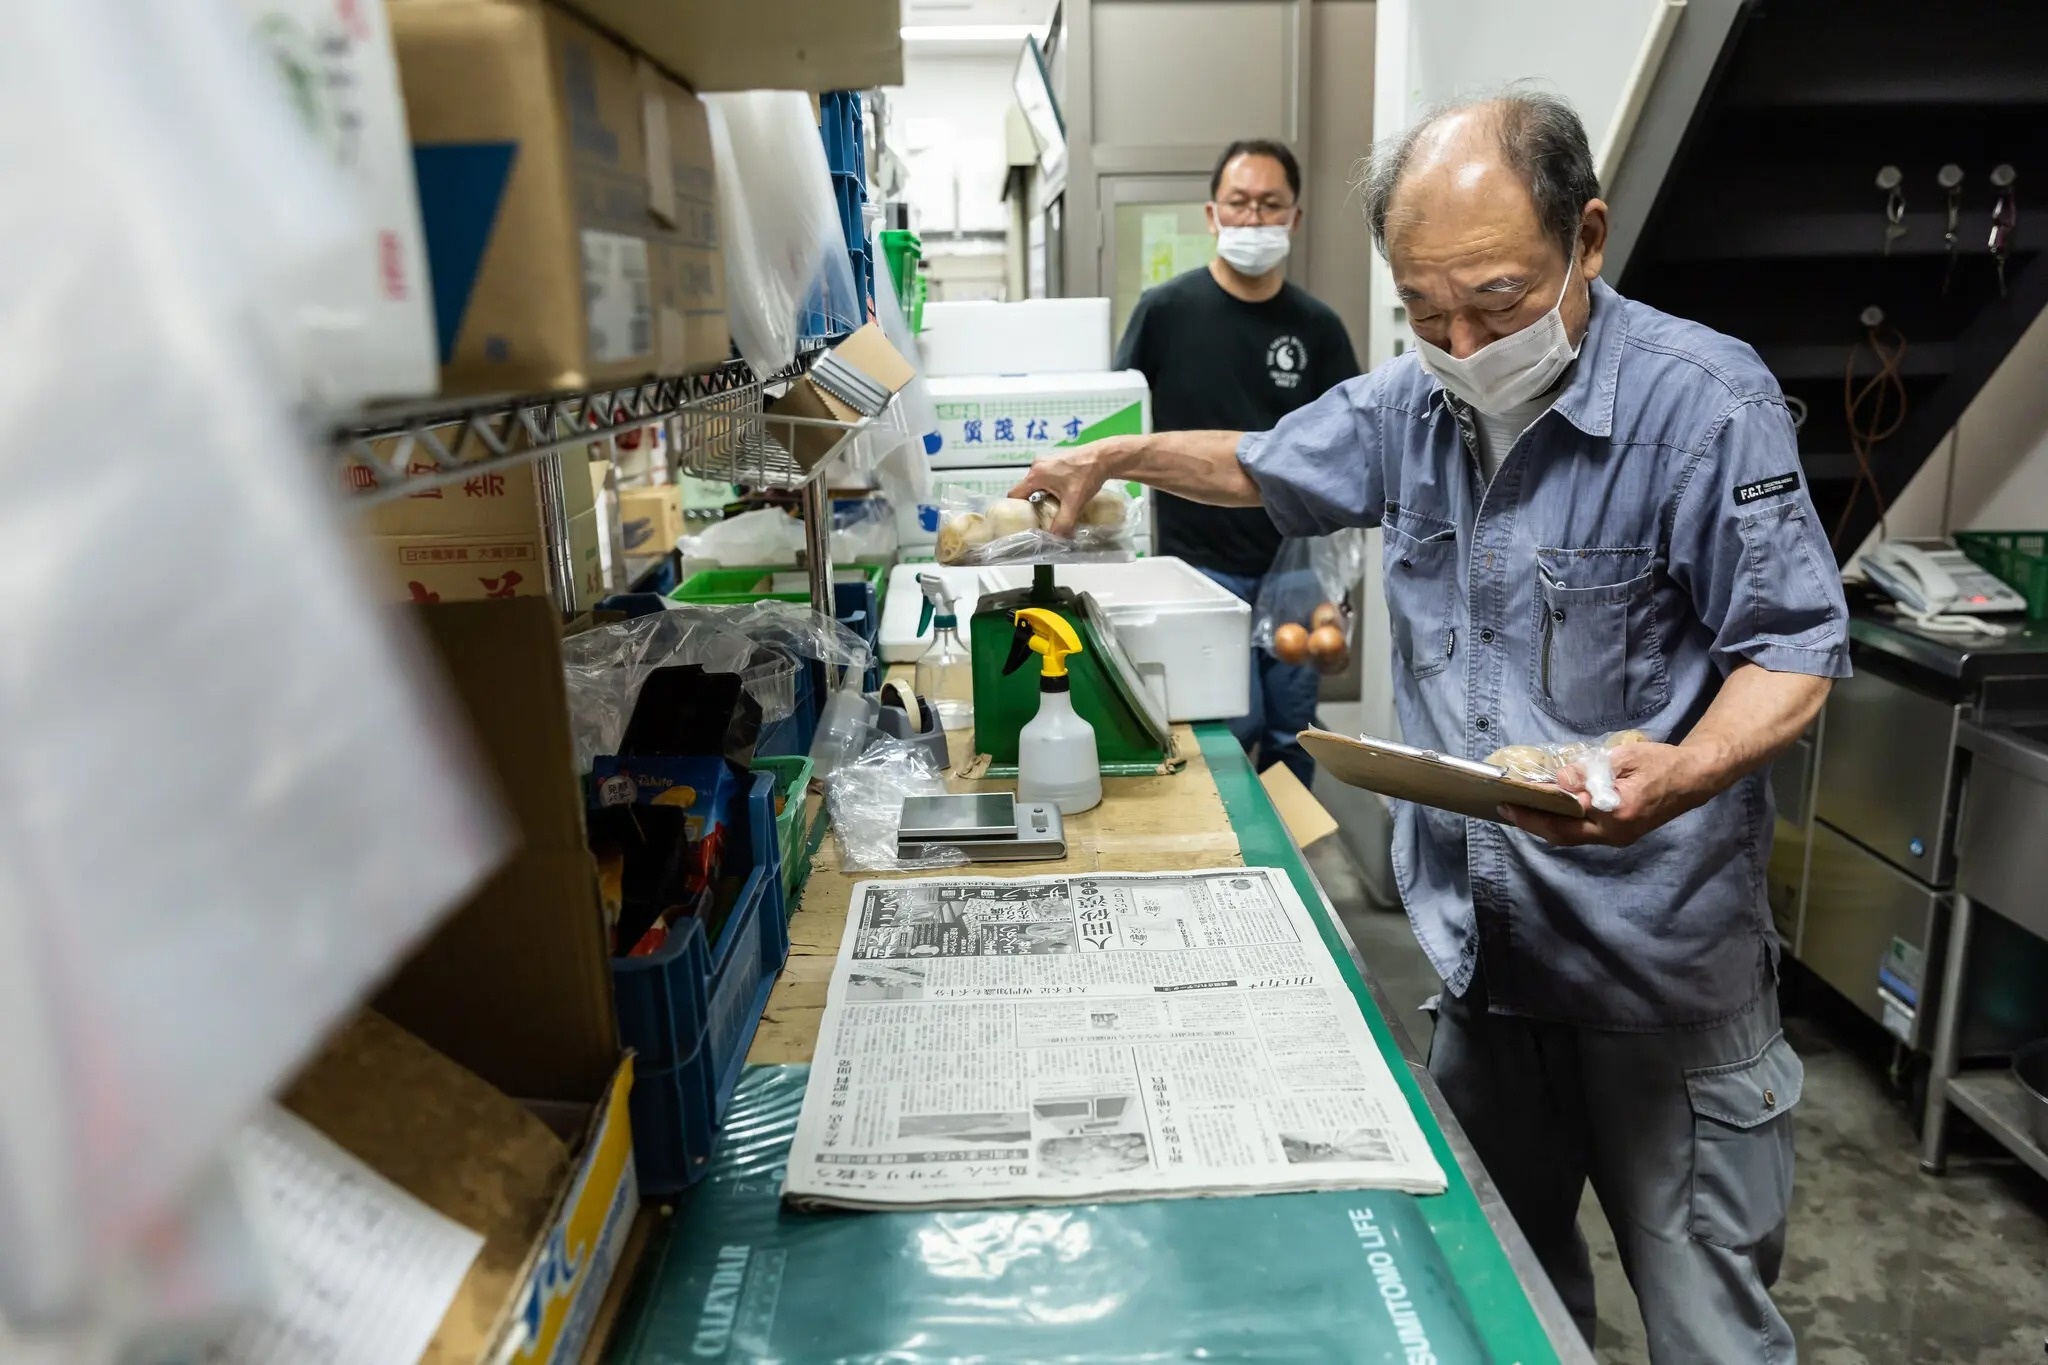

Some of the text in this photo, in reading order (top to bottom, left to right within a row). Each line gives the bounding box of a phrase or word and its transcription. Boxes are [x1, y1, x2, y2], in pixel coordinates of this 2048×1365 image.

[964, 416, 1083, 443] 賀茂なす
[1740, 485, 1764, 500] F.C.T.
[1077, 895, 1113, 949] 人間砂漠
[692, 1245, 750, 1356] CALENDAR
[1348, 1207, 1438, 1365] SUMITOMO LIFE
